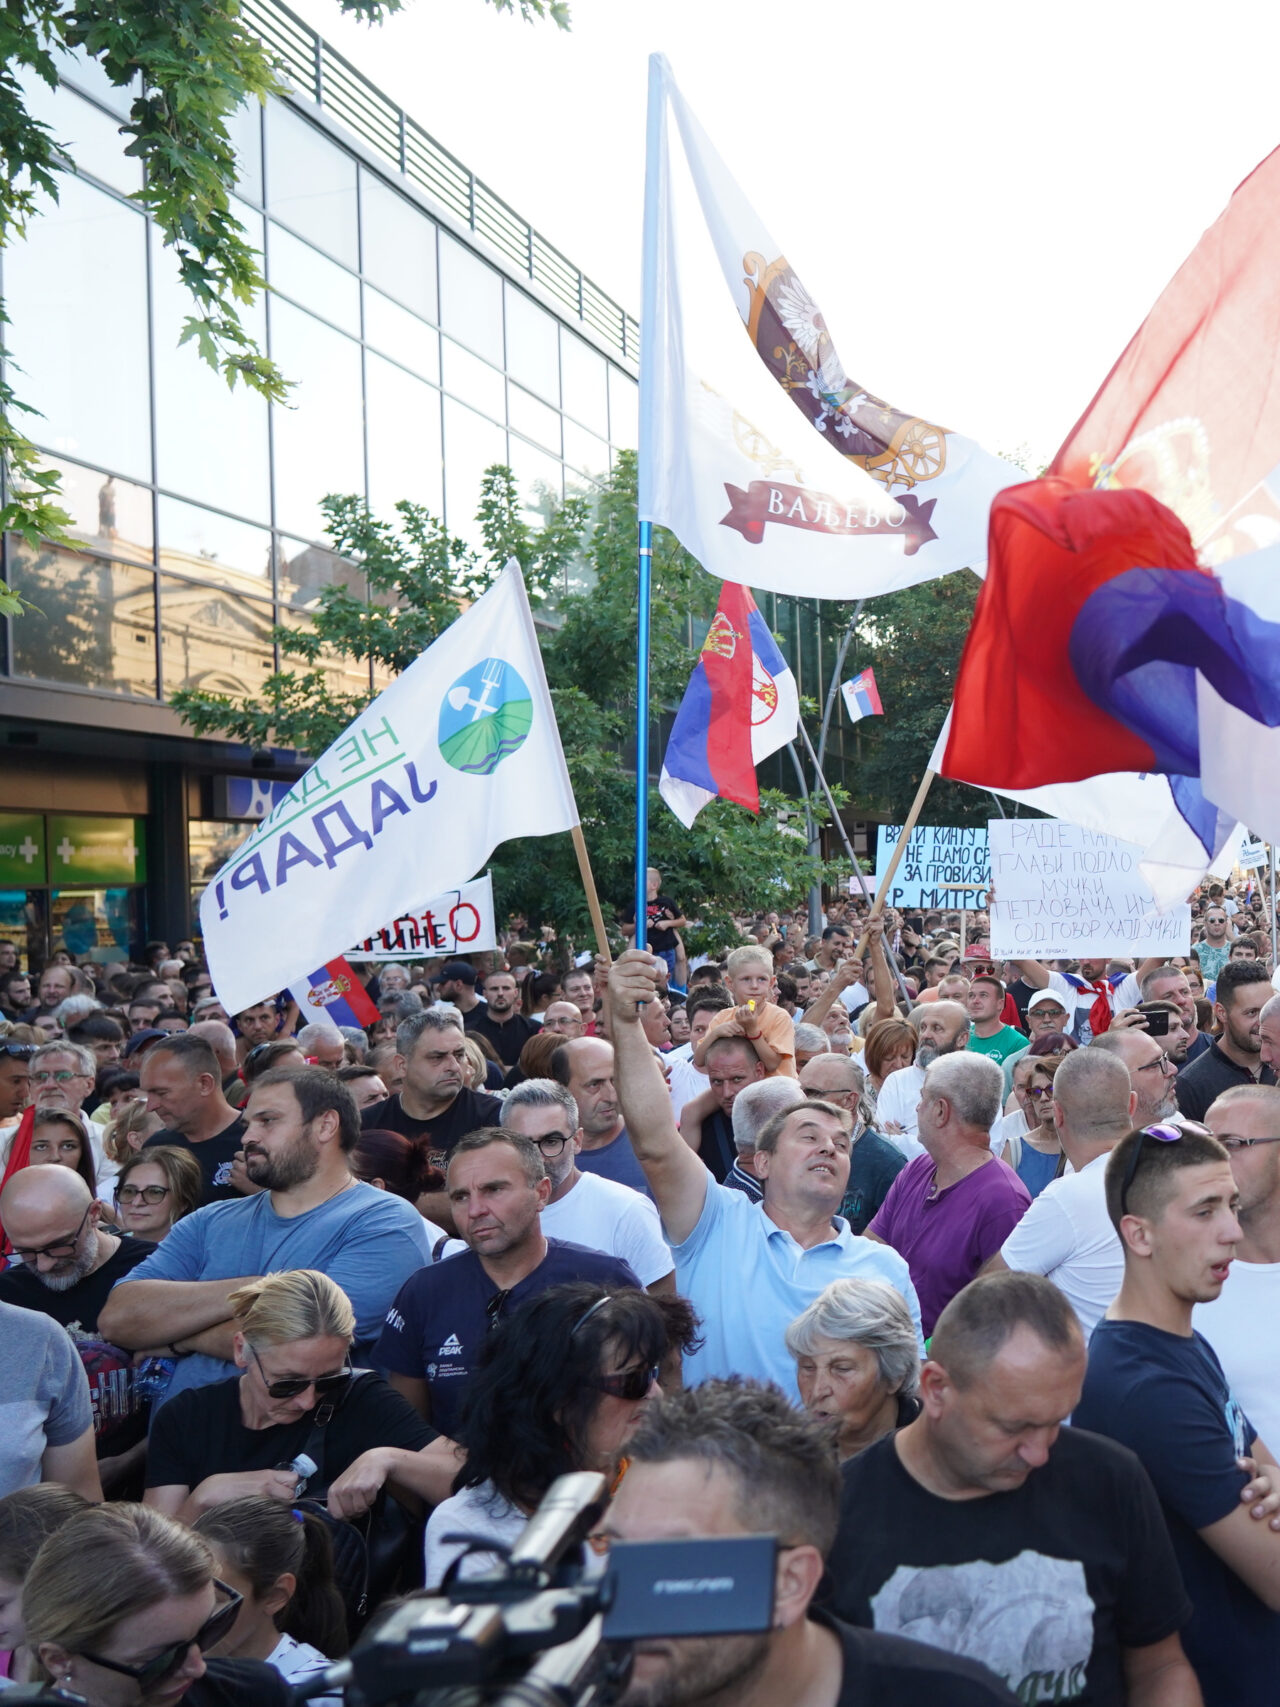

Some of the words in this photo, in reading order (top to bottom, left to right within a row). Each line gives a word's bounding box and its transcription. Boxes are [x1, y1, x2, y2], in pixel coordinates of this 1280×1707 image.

[767, 488, 906, 528] ВАЉЕВО
[885, 825, 926, 844] ВРТИ
[933, 826, 976, 846] КИНТУ
[1011, 823, 1073, 848] РАДЕ
[906, 845, 924, 863] НЕ
[929, 846, 970, 864] ДАМО
[999, 853, 1063, 875] ГЛАВИ
[1073, 850, 1132, 873] ПОДЛО
[904, 864, 922, 882] ЗА
[1041, 876, 1104, 899] МУЧКИ
[994, 896, 1116, 920] ПЕТЛОВАЧА
[438, 1345, 464, 1356] PEAK
